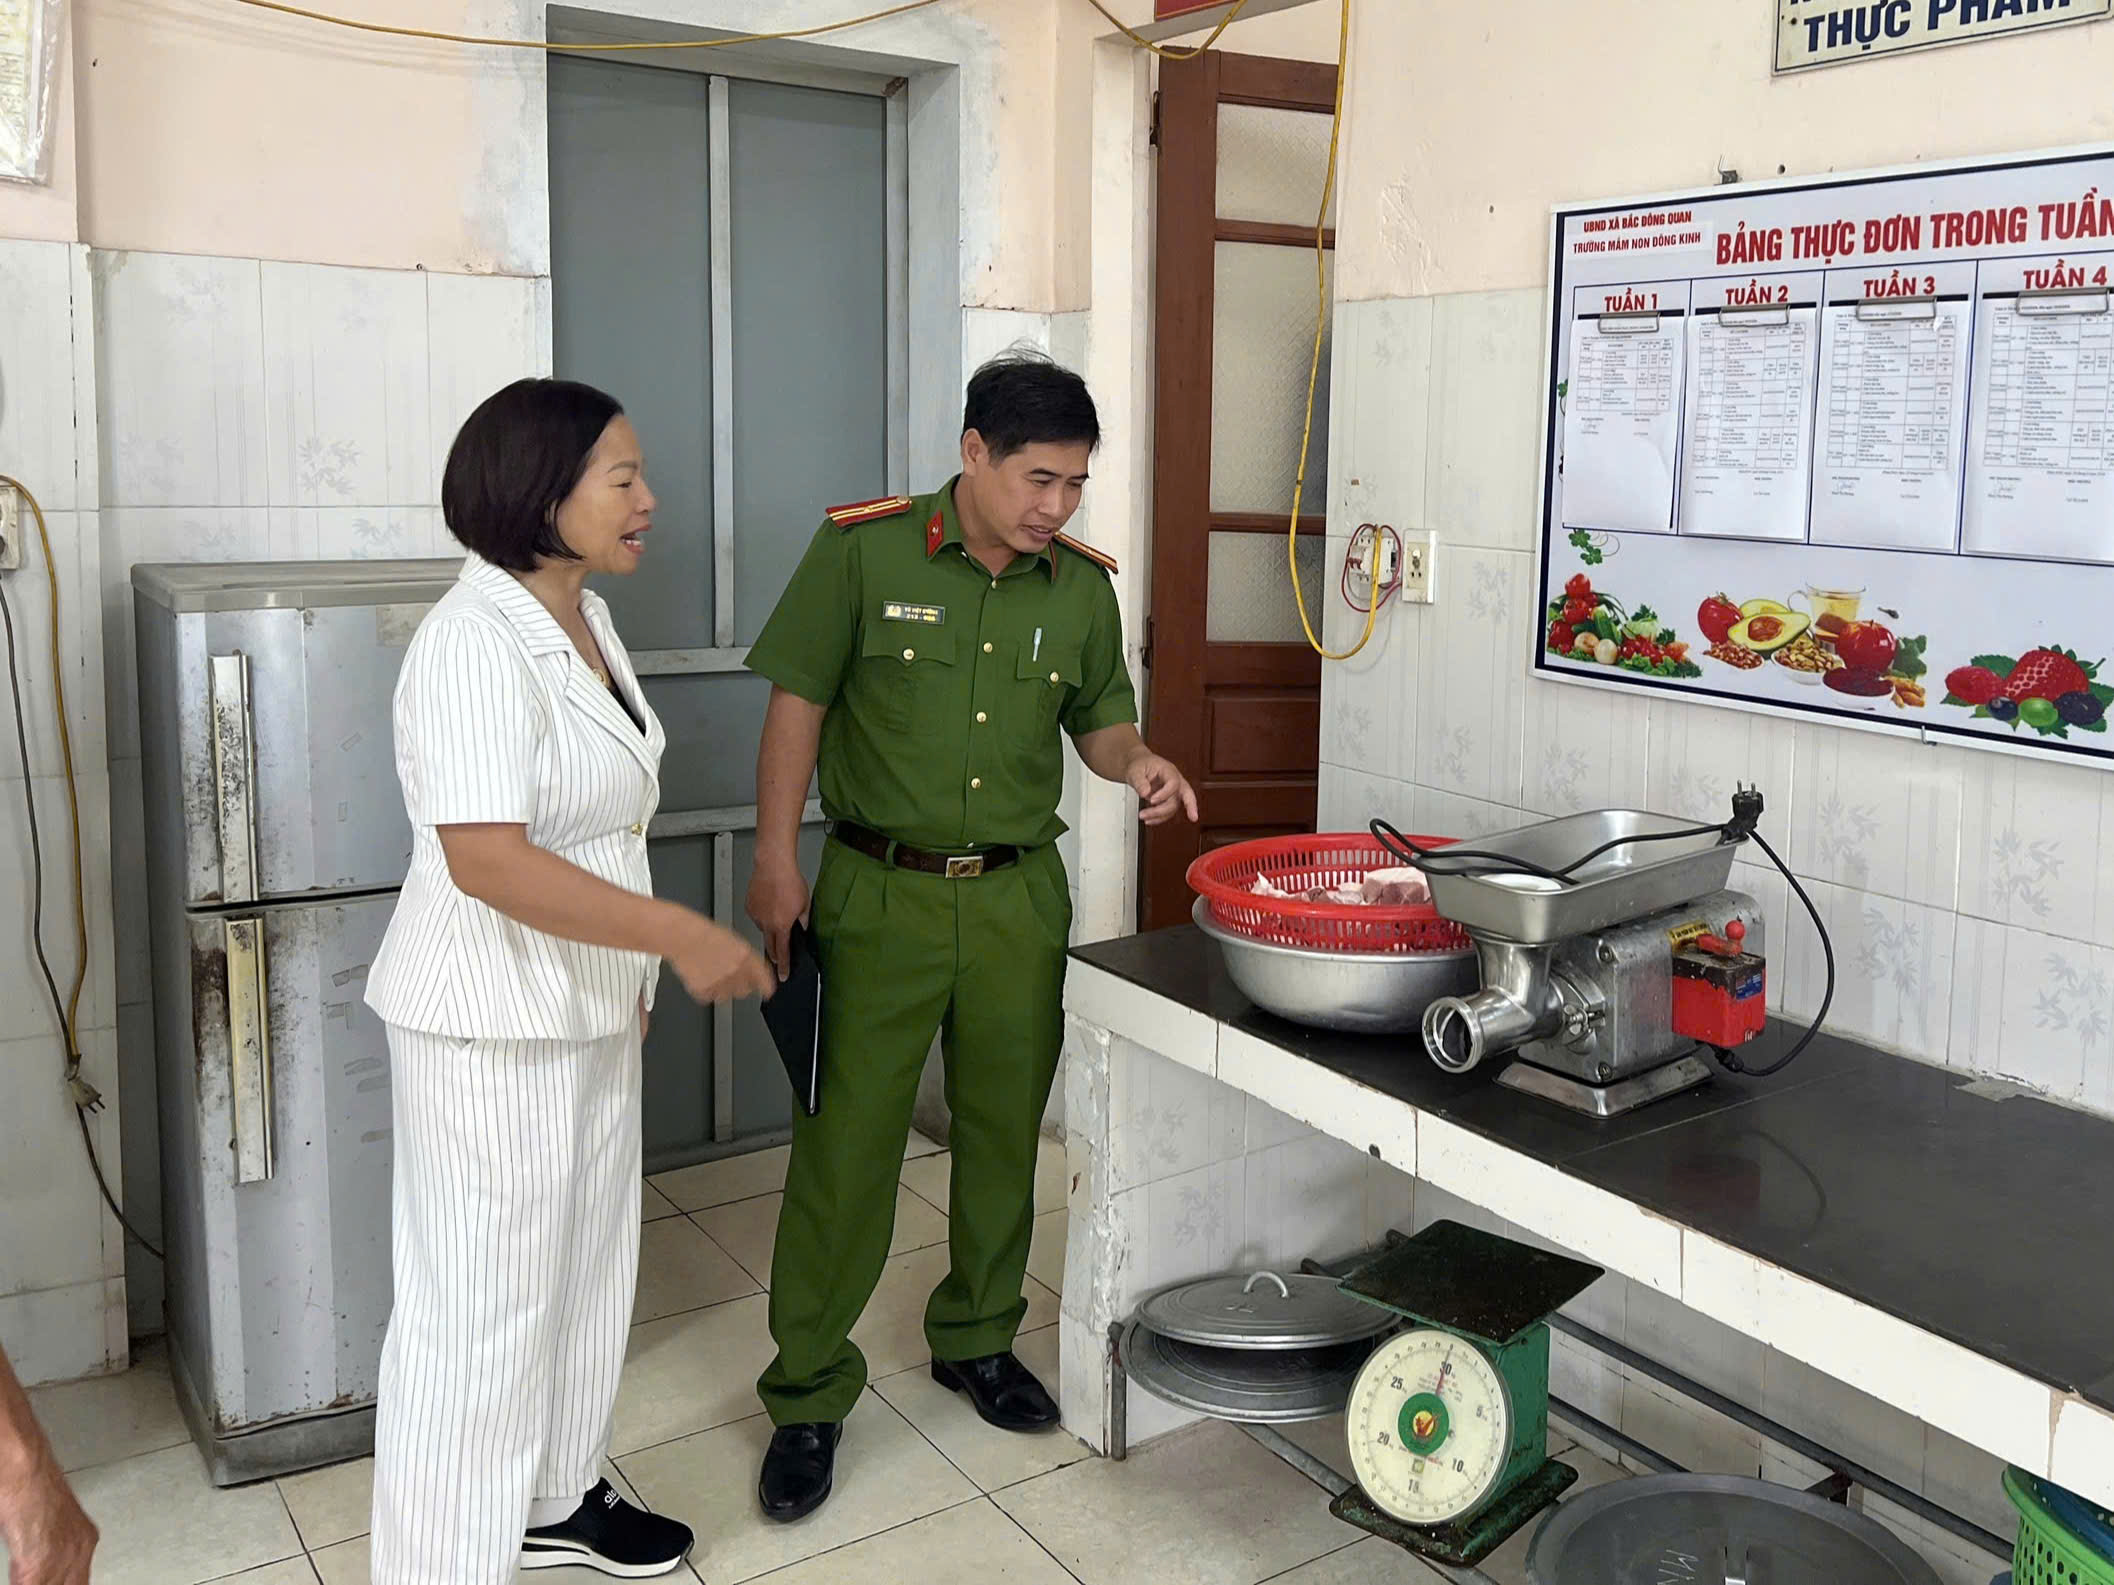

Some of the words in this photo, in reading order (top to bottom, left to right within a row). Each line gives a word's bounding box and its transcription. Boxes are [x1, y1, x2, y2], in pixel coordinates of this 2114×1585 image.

[1804, 0, 1911, 52] THỰC
[1583, 220, 1607, 233] UBND
[1622, 212, 1639, 229] BẮC
[1641, 212, 1665, 227] ĐÔNG
[1667, 210, 1692, 225] QUAN
[1631, 237, 1650, 250] NON
[1679, 231, 1701, 245] KINH
[1716, 221, 1783, 265] BẢNG
[1790, 219, 1855, 265] THỰC
[1863, 213, 1921, 254] ĐƠN
[1930, 206, 2028, 249] TRONG
[1863, 269, 1912, 298] TUẦN
[1923, 276, 1936, 295] 3
[2023, 259, 2086, 290] TUẦN
[2091, 266, 2107, 287] 4
[1604, 287, 1645, 312] TUẦN
[1652, 293, 1658, 309] 1
[1725, 278, 1773, 305] TUẦN
[1777, 285, 1788, 303] 2
[1390, 1376, 1404, 1390] 25
[1377, 1431, 1390, 1446] 20
[1452, 1458, 1464, 1473] 10
